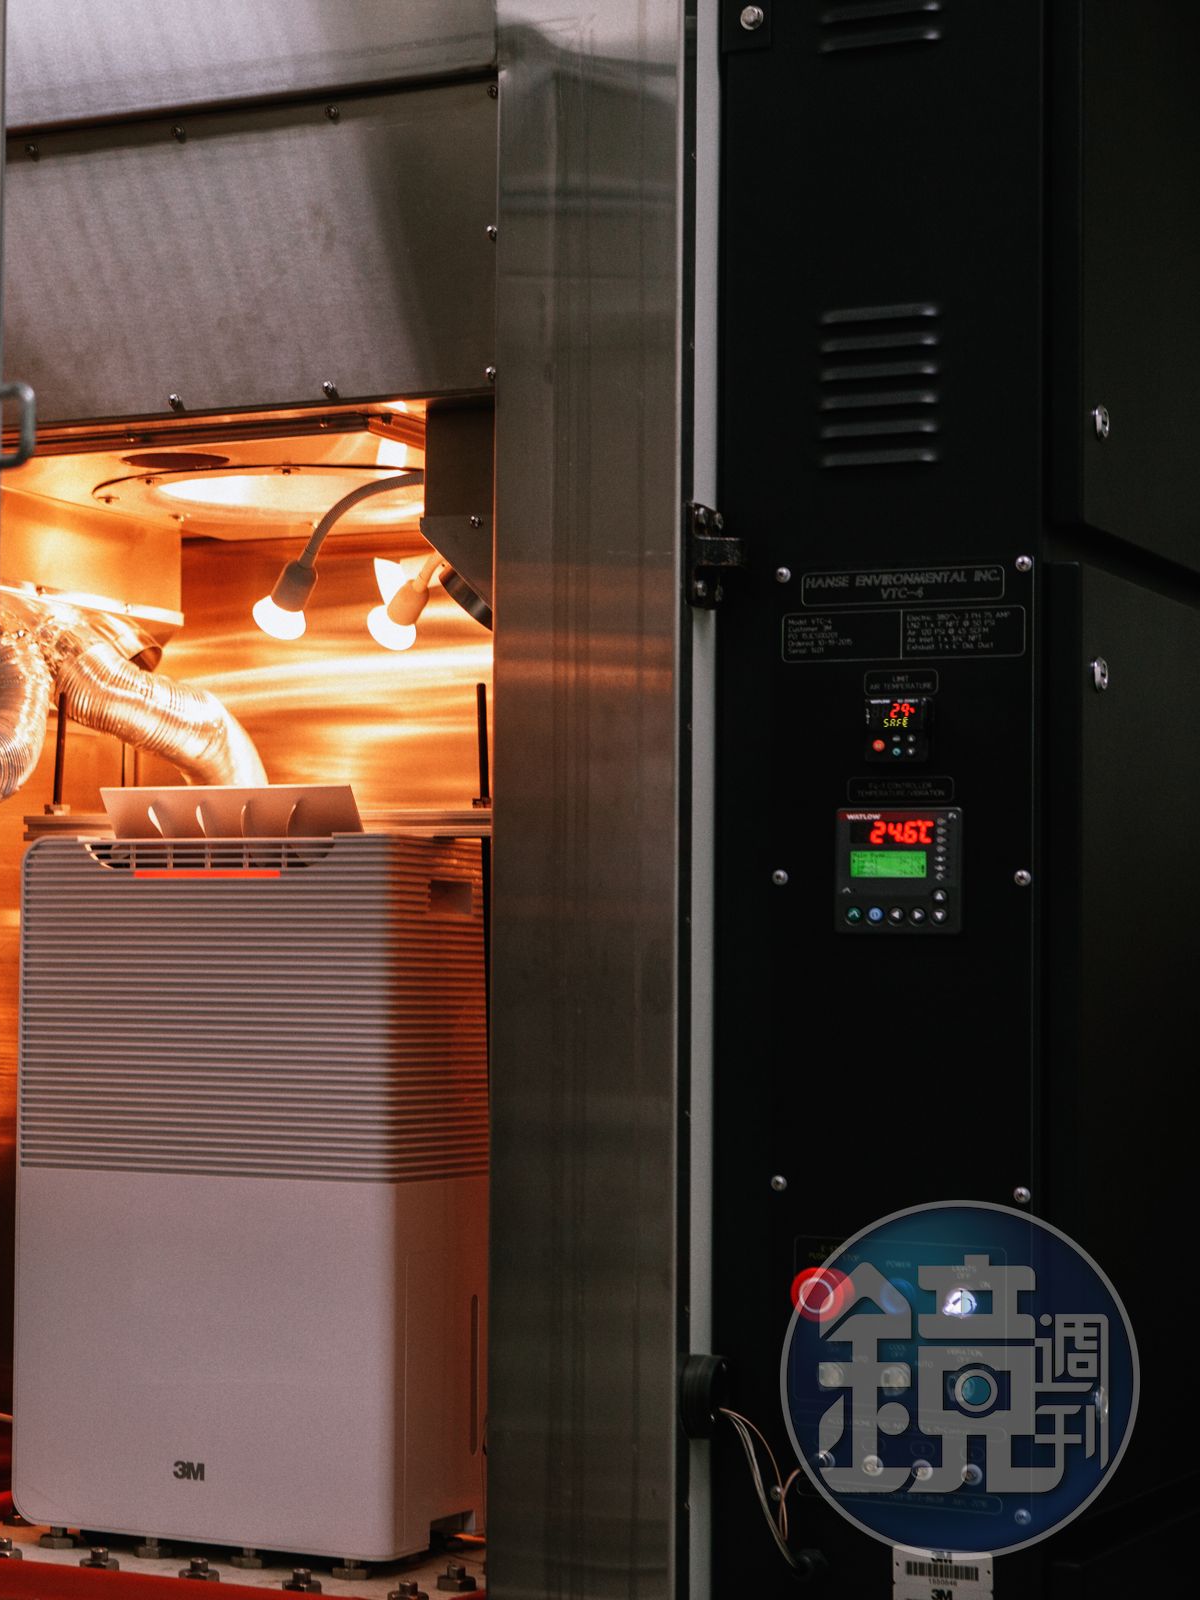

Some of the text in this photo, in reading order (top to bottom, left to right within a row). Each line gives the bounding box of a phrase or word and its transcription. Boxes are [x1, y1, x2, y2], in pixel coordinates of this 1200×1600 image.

[806, 568, 1001, 589] HANSE ENVIRONMENTAL INC.
[883, 681, 932, 690] TEMPERATURE
[173, 1460, 205, 1481] 3M
